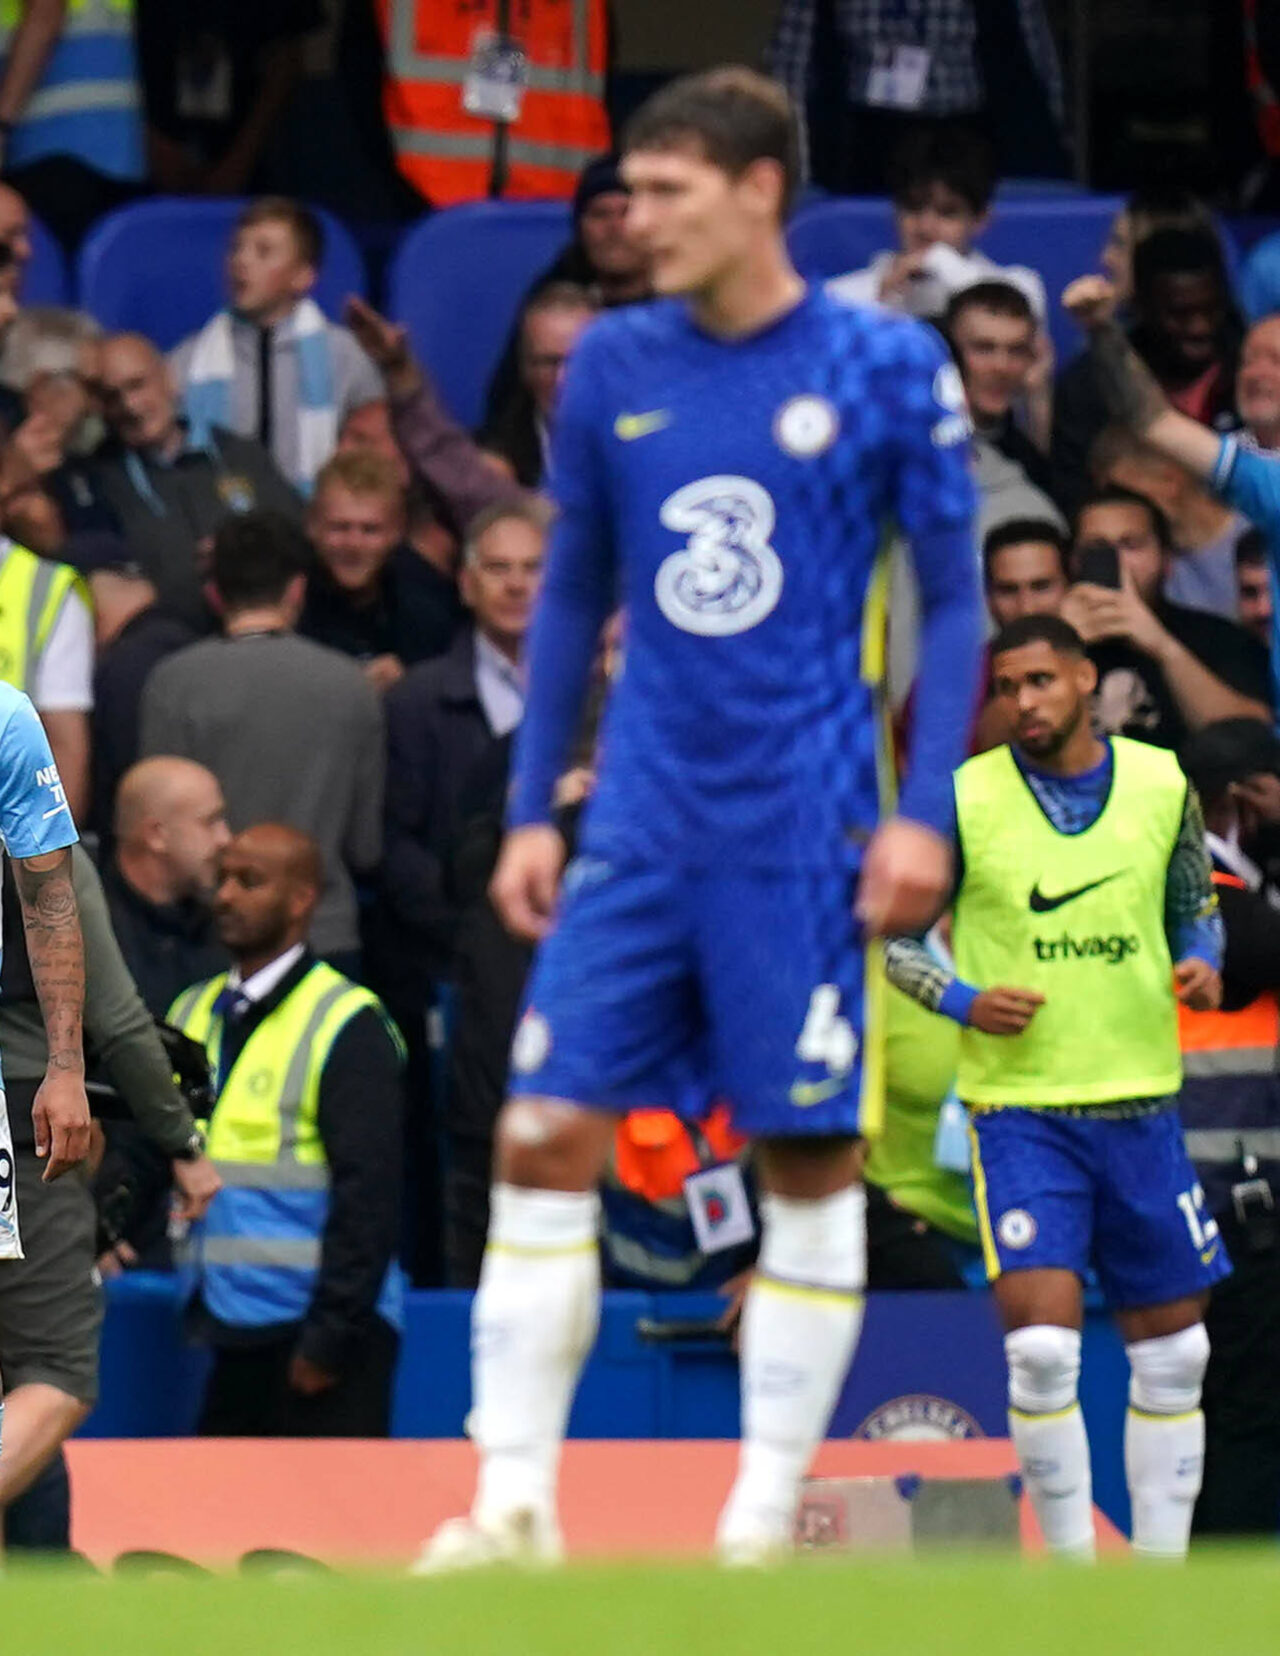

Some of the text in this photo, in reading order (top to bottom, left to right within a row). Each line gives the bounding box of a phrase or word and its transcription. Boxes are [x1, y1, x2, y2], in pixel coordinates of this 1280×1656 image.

[654, 474, 785, 637] 3
[1034, 930, 1140, 965] trivago
[795, 983, 859, 1073] 4
